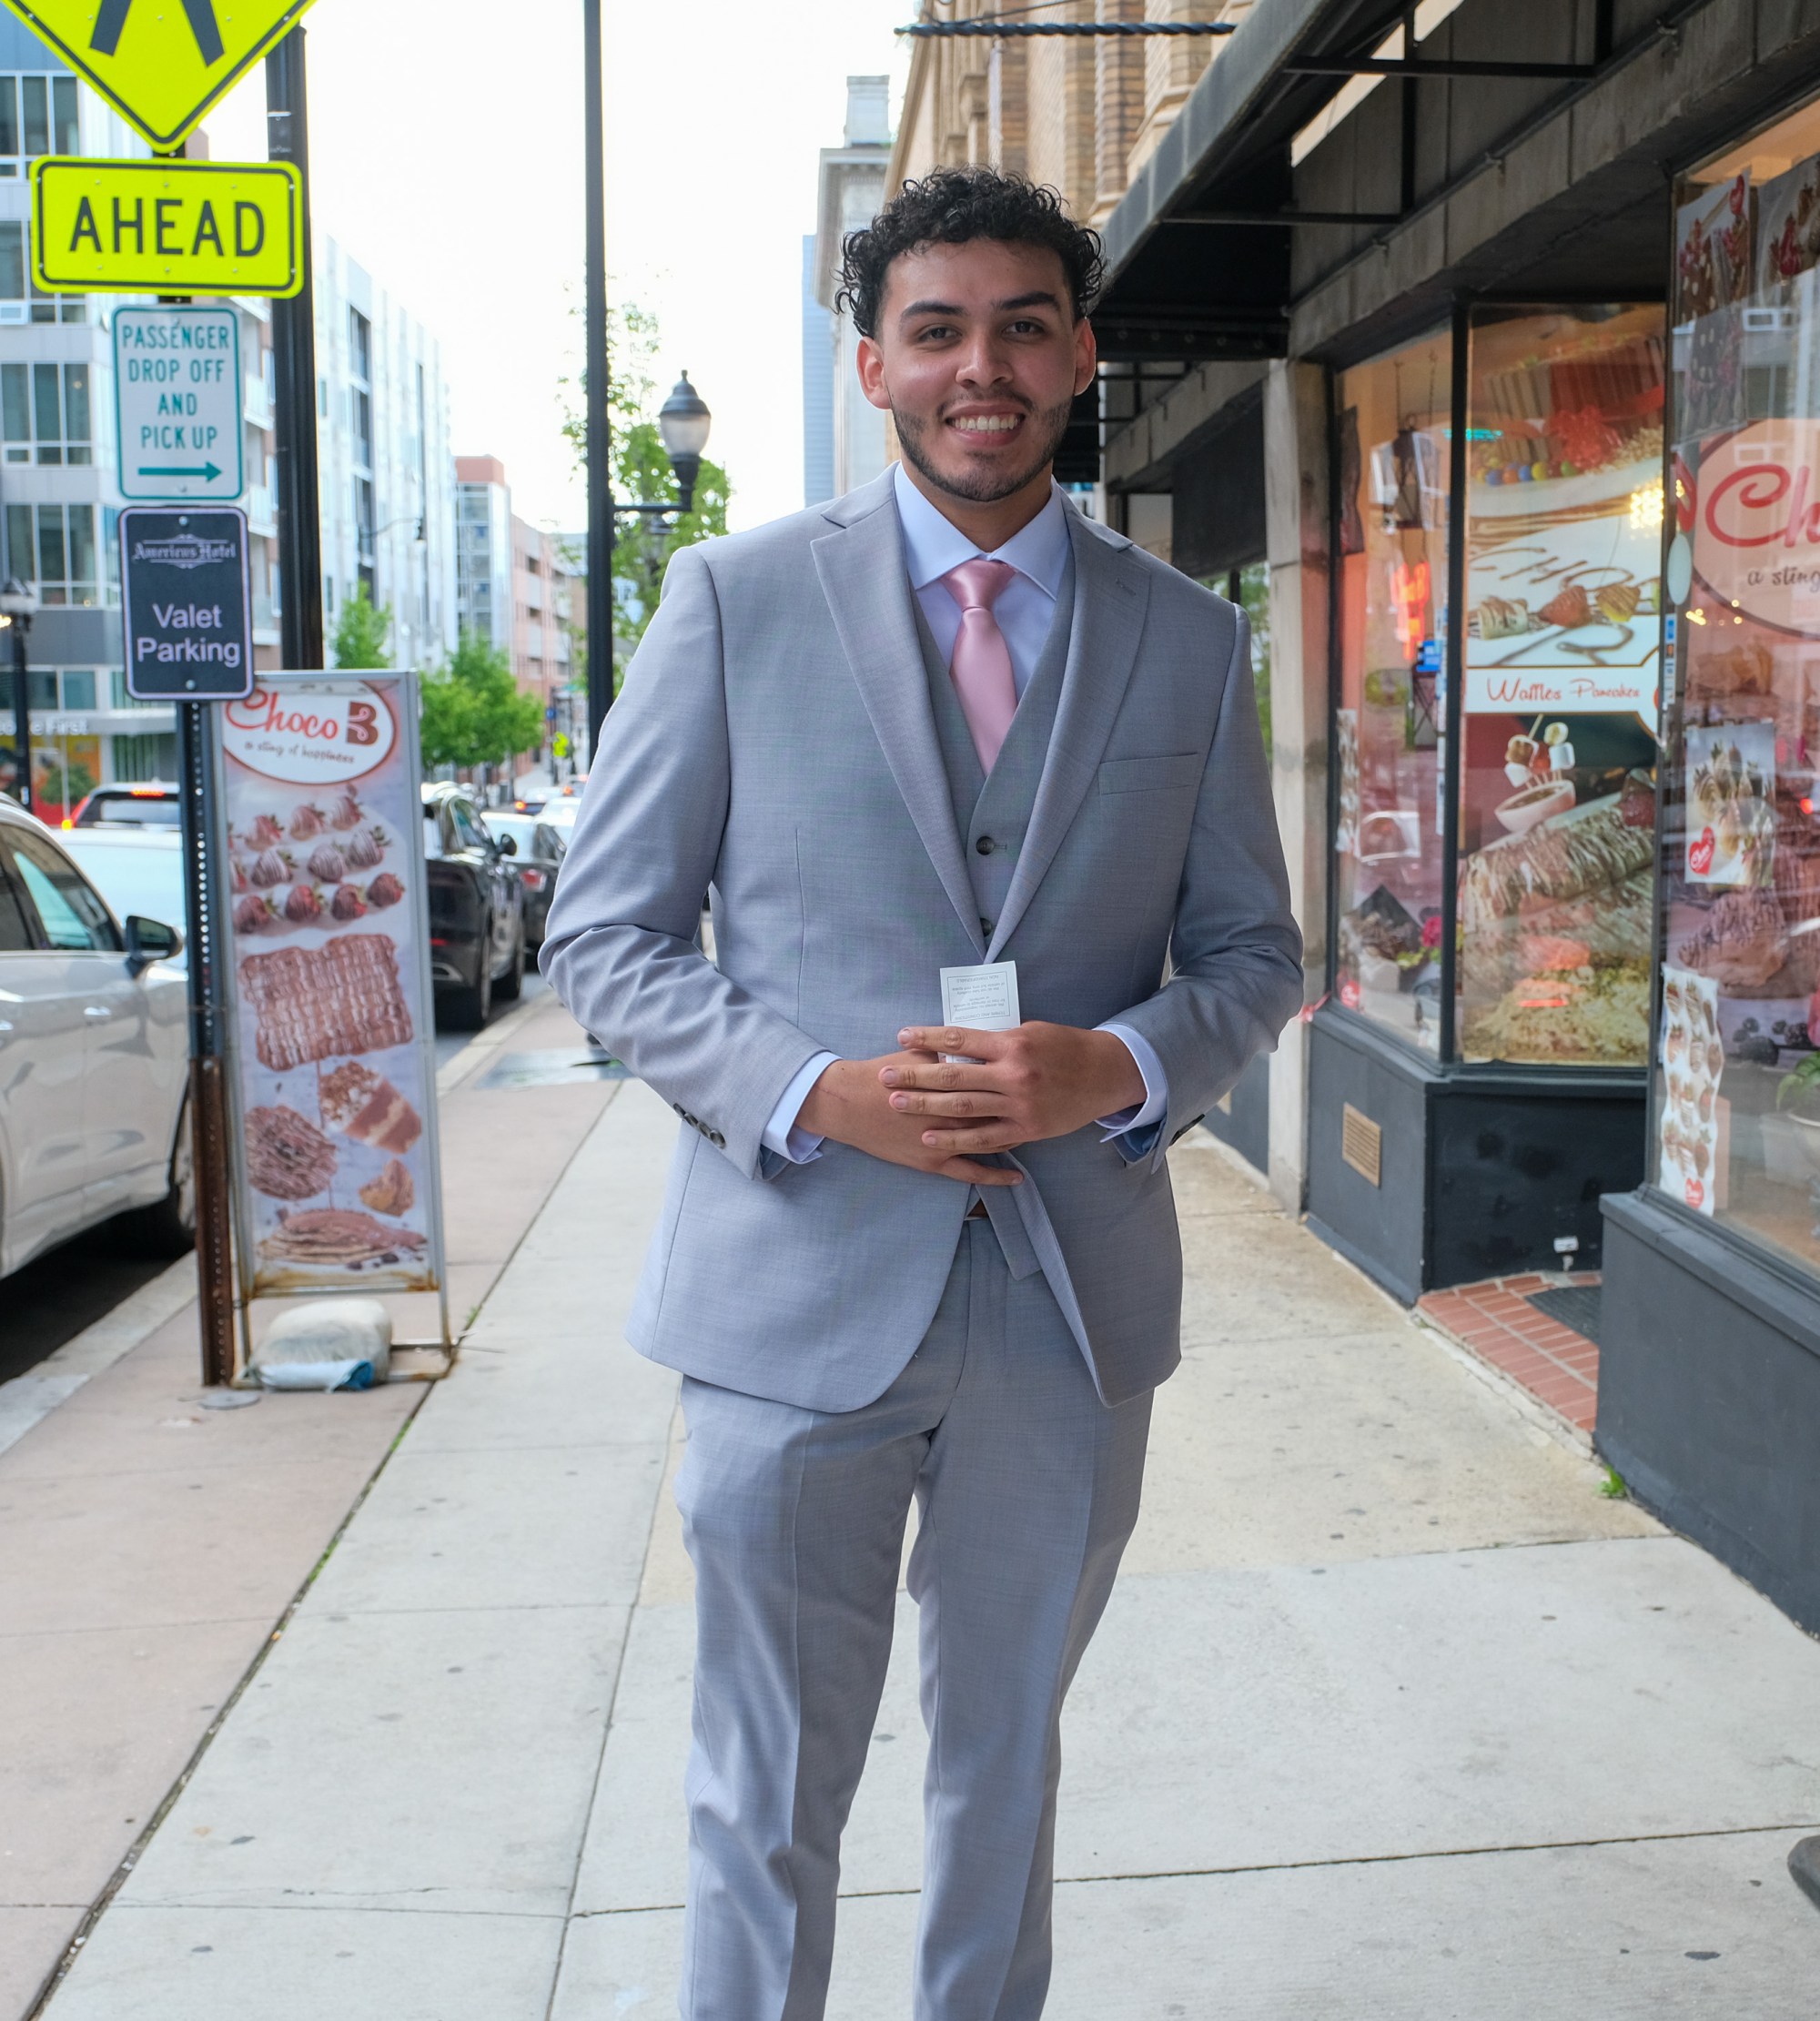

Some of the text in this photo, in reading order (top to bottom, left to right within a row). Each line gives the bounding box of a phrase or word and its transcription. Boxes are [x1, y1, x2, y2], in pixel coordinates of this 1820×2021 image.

[69, 197, 265, 257] AHEAD
[122, 325, 229, 349] PASSENGER
[128, 359, 226, 382] DROP OFF
[157, 392, 197, 416] AND
[141, 426, 217, 450] PICK UP
[197, 541, 236, 561] Hotel
[1747, 566, 1820, 593] a sting
[152, 603, 223, 629] Valet
[136, 637, 240, 668] Parking
[1486, 677, 1641, 702] Waffles Pancakes
[225, 687, 339, 741] Choco
